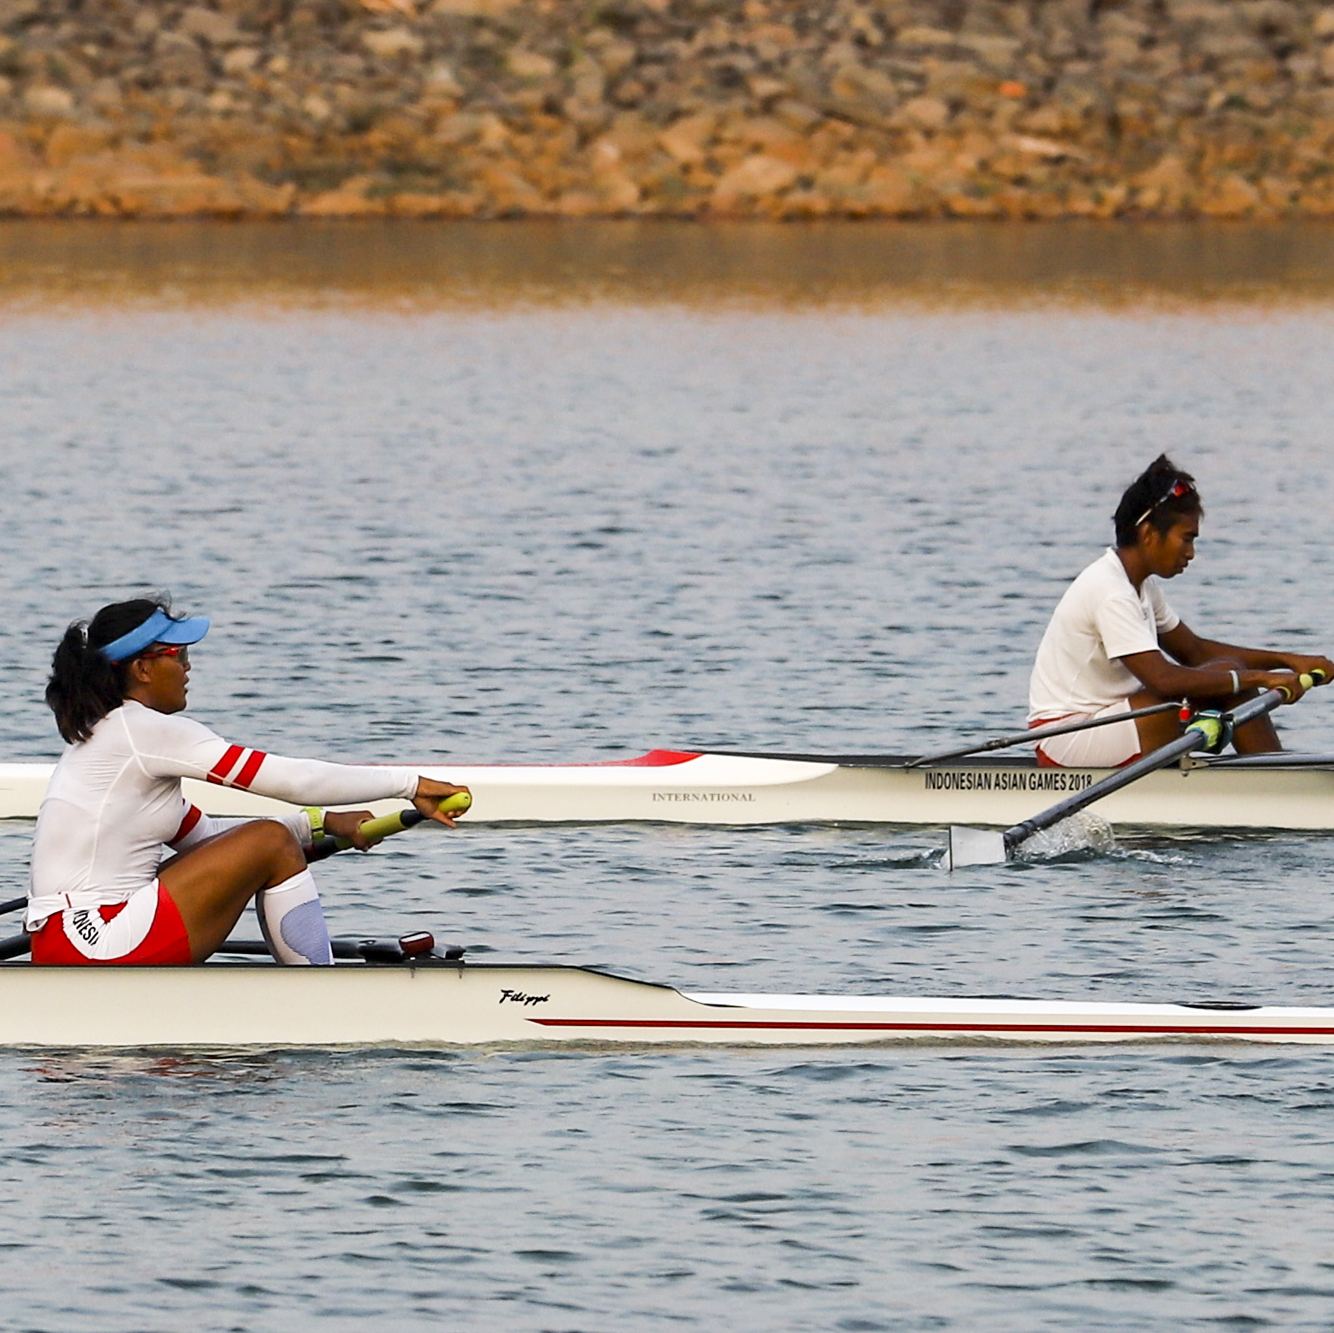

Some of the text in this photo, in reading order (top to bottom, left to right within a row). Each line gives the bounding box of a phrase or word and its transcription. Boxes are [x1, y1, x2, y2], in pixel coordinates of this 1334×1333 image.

[924, 772, 1092, 791] INDONESIAN ASIAN GAMES 2018
[652, 792, 756, 802] INTERNATIONAL
[498, 989, 551, 1006] Filippi
